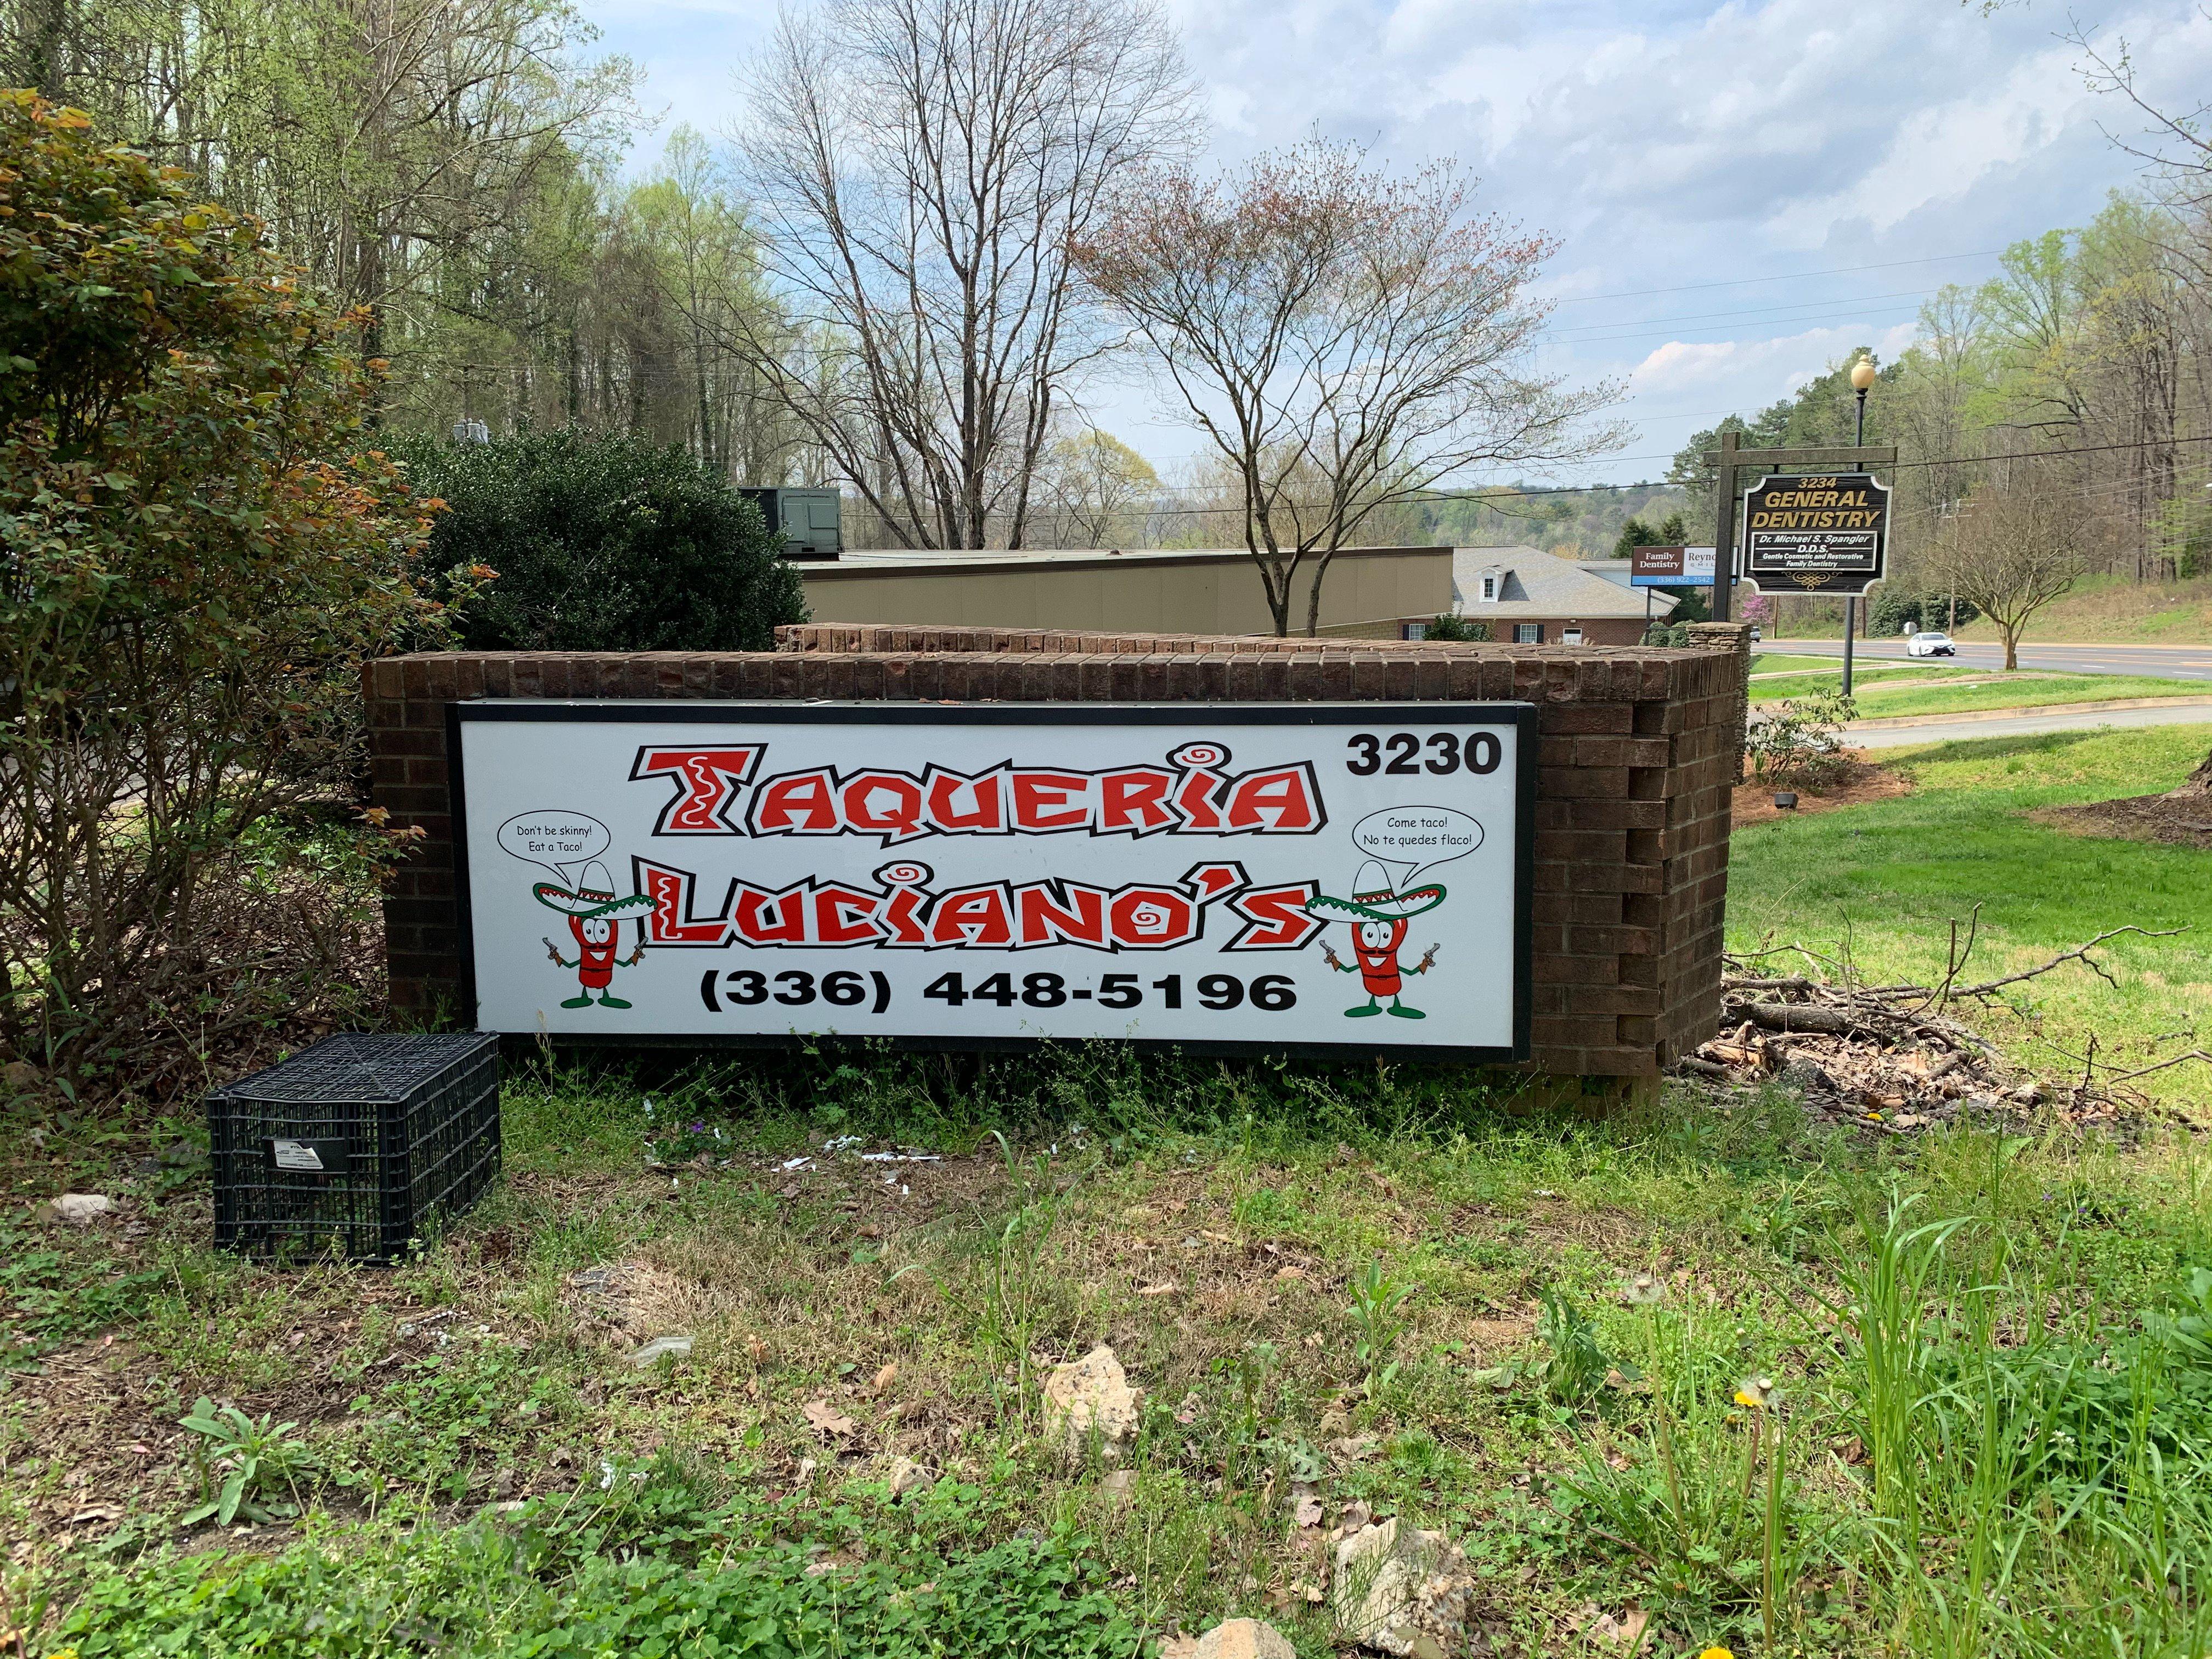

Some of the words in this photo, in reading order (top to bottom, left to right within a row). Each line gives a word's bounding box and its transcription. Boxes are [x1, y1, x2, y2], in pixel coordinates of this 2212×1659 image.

[1798, 477, 1837, 488] 3234
[1765, 490, 1869, 507] GENERAL
[1751, 511, 1881, 528] DENTISTRY
[1774, 535, 1812, 543] Michael
[1813, 535, 1821, 543] S.
[1825, 535, 1870, 544] Spangler
[1797, 545, 1829, 553] D.D.S.
[1646, 552, 1675, 561] Family
[1689, 552, 1716, 563] Reyno
[1640, 561, 1680, 569] Dentistry
[1346, 732, 1502, 775] 3230
[628, 741, 1328, 849] TAQUERIA
[1387, 817, 1417, 828] Come
[1420, 817, 1447, 827] taco!
[517, 825, 541, 836] Don't
[545, 825, 557, 836] be
[560, 825, 592, 838] skinny!
[529, 841, 545, 851] Eat
[557, 841, 582, 851] Taco!
[1364, 834, 1379, 845] No
[1383, 835, 1395, 845] te
[1398, 834, 1437, 848] quedes
[1441, 834, 1472, 845] flaco!
[631, 855, 1330, 954] LUCIANO'S
[701, 969, 891, 1014] (336)
[923, 972, 1297, 1011] 448-5196
